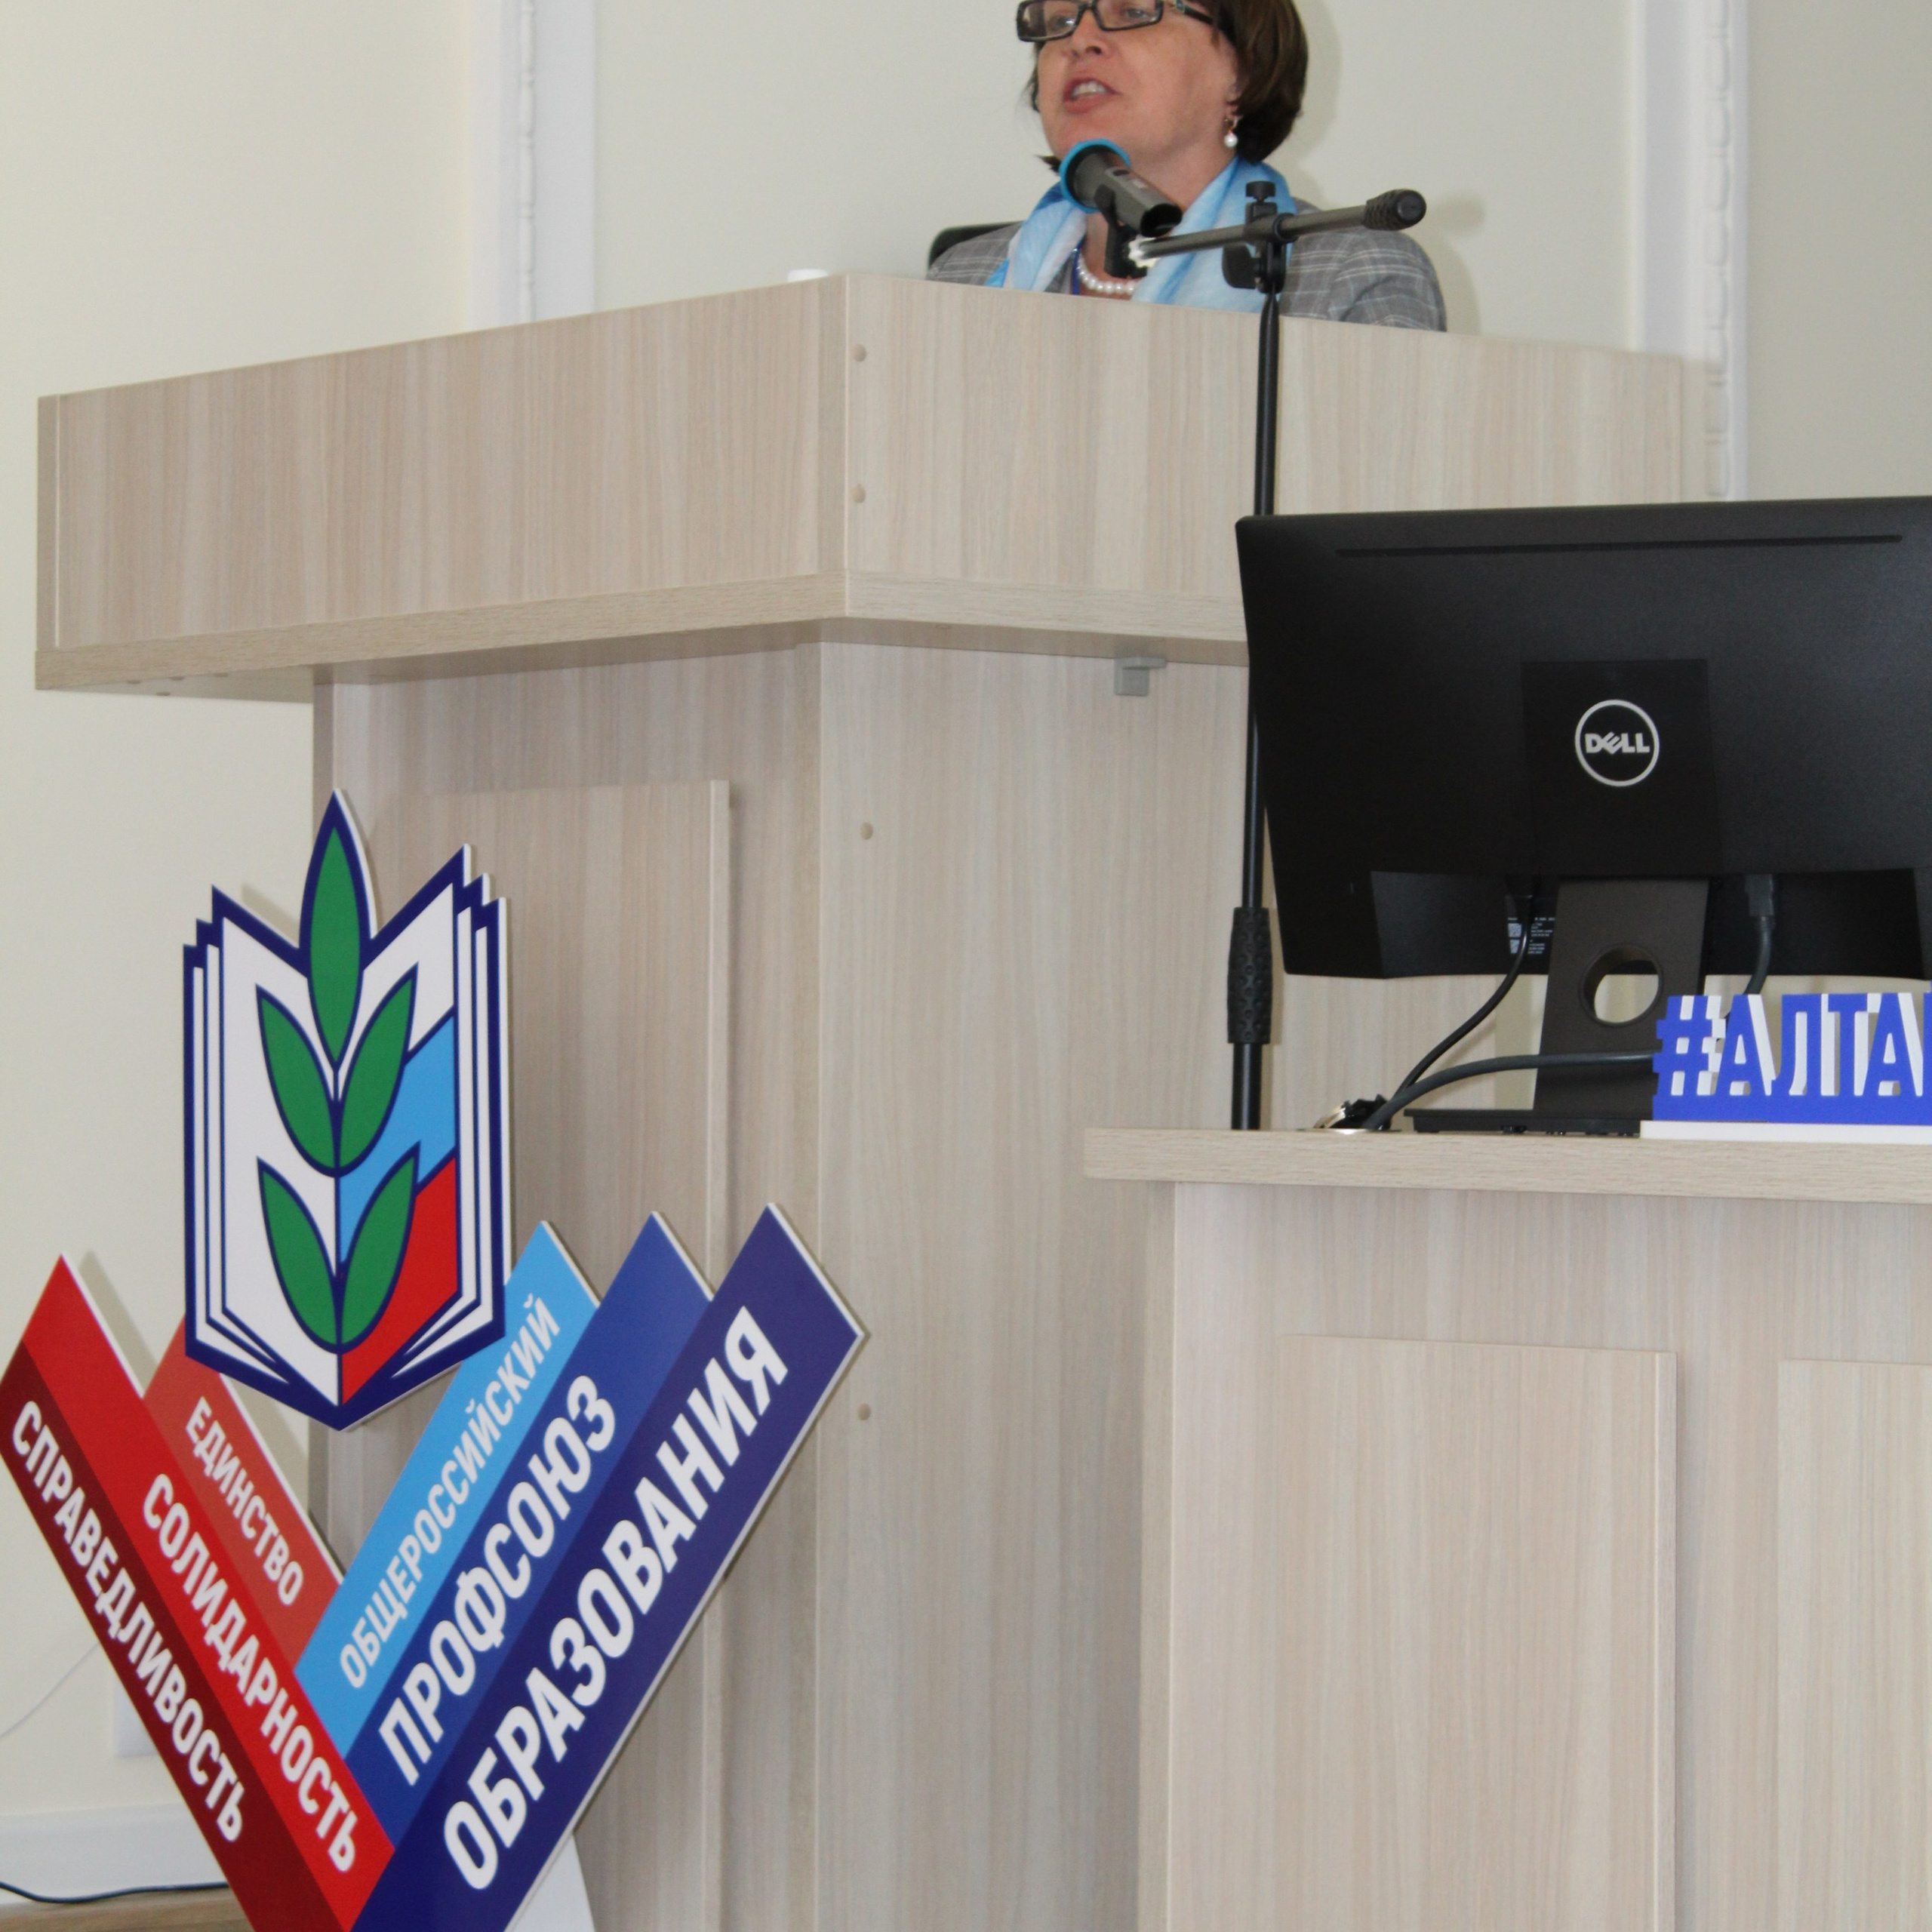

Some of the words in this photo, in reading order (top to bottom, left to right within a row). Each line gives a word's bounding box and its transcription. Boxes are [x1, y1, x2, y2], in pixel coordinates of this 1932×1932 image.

[1585, 731, 1651, 755] DELL
[1653, 990, 1932, 1097] #АЛТА
[12, 1401, 244, 1842] СПРАВЕДЛИВОСТЬ
[143, 1474, 357, 1872] СОЛИДАРНОСТЬ
[186, 1396, 304, 1606] ЕДИНСТВО
[339, 1294, 561, 1688] ОБЩЕРОССИЙСКИЙ
[379, 1375, 616, 1786] ПРОФСОЮЗ
[443, 1306, 789, 1890] ОБРАЗОВАНИЯ
